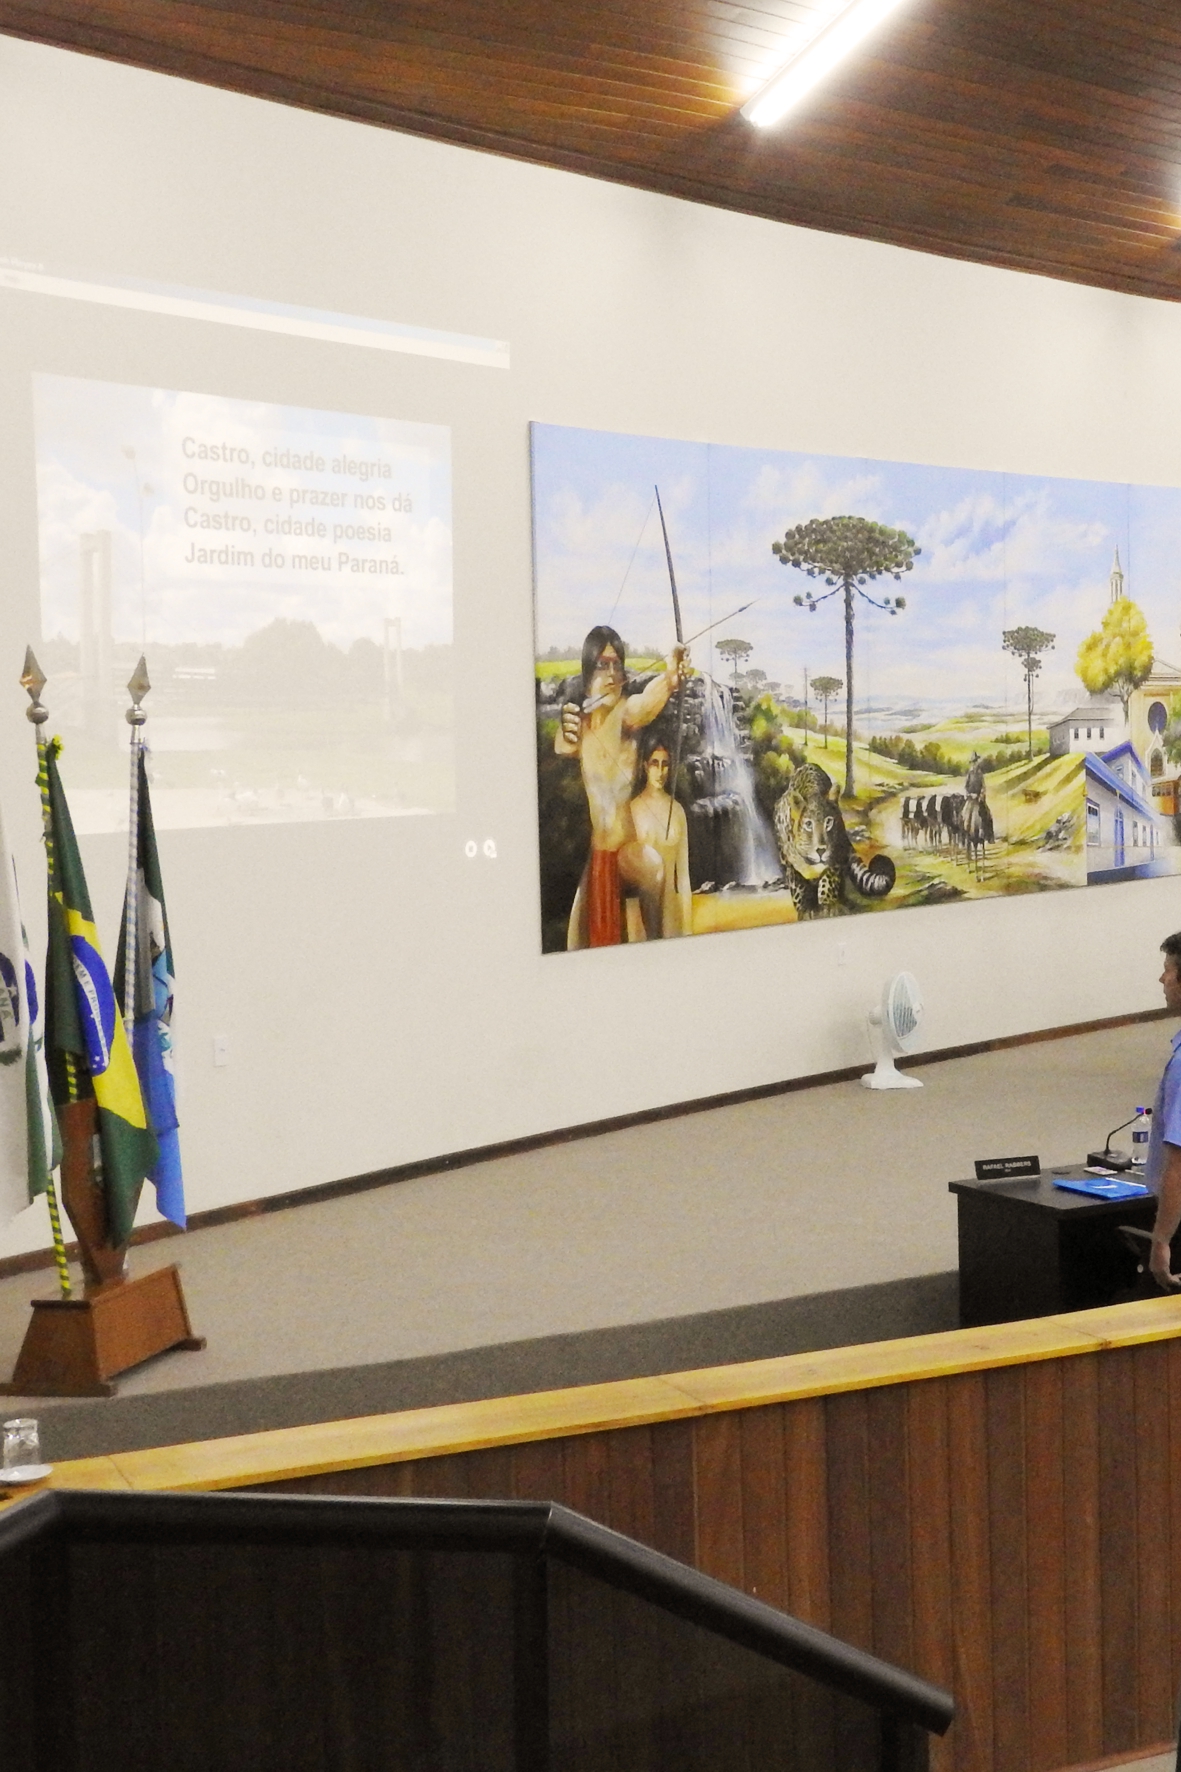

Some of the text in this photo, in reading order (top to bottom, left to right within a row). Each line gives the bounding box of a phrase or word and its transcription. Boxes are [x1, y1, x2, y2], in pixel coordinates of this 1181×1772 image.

[181, 436, 392, 481] Castro, cidade alegria
[182, 472, 413, 513] Orgulho e prazer nos dá
[184, 506, 392, 544] Castro, cidade poesia
[185, 542, 405, 576] Jardim do meu Paraná.
